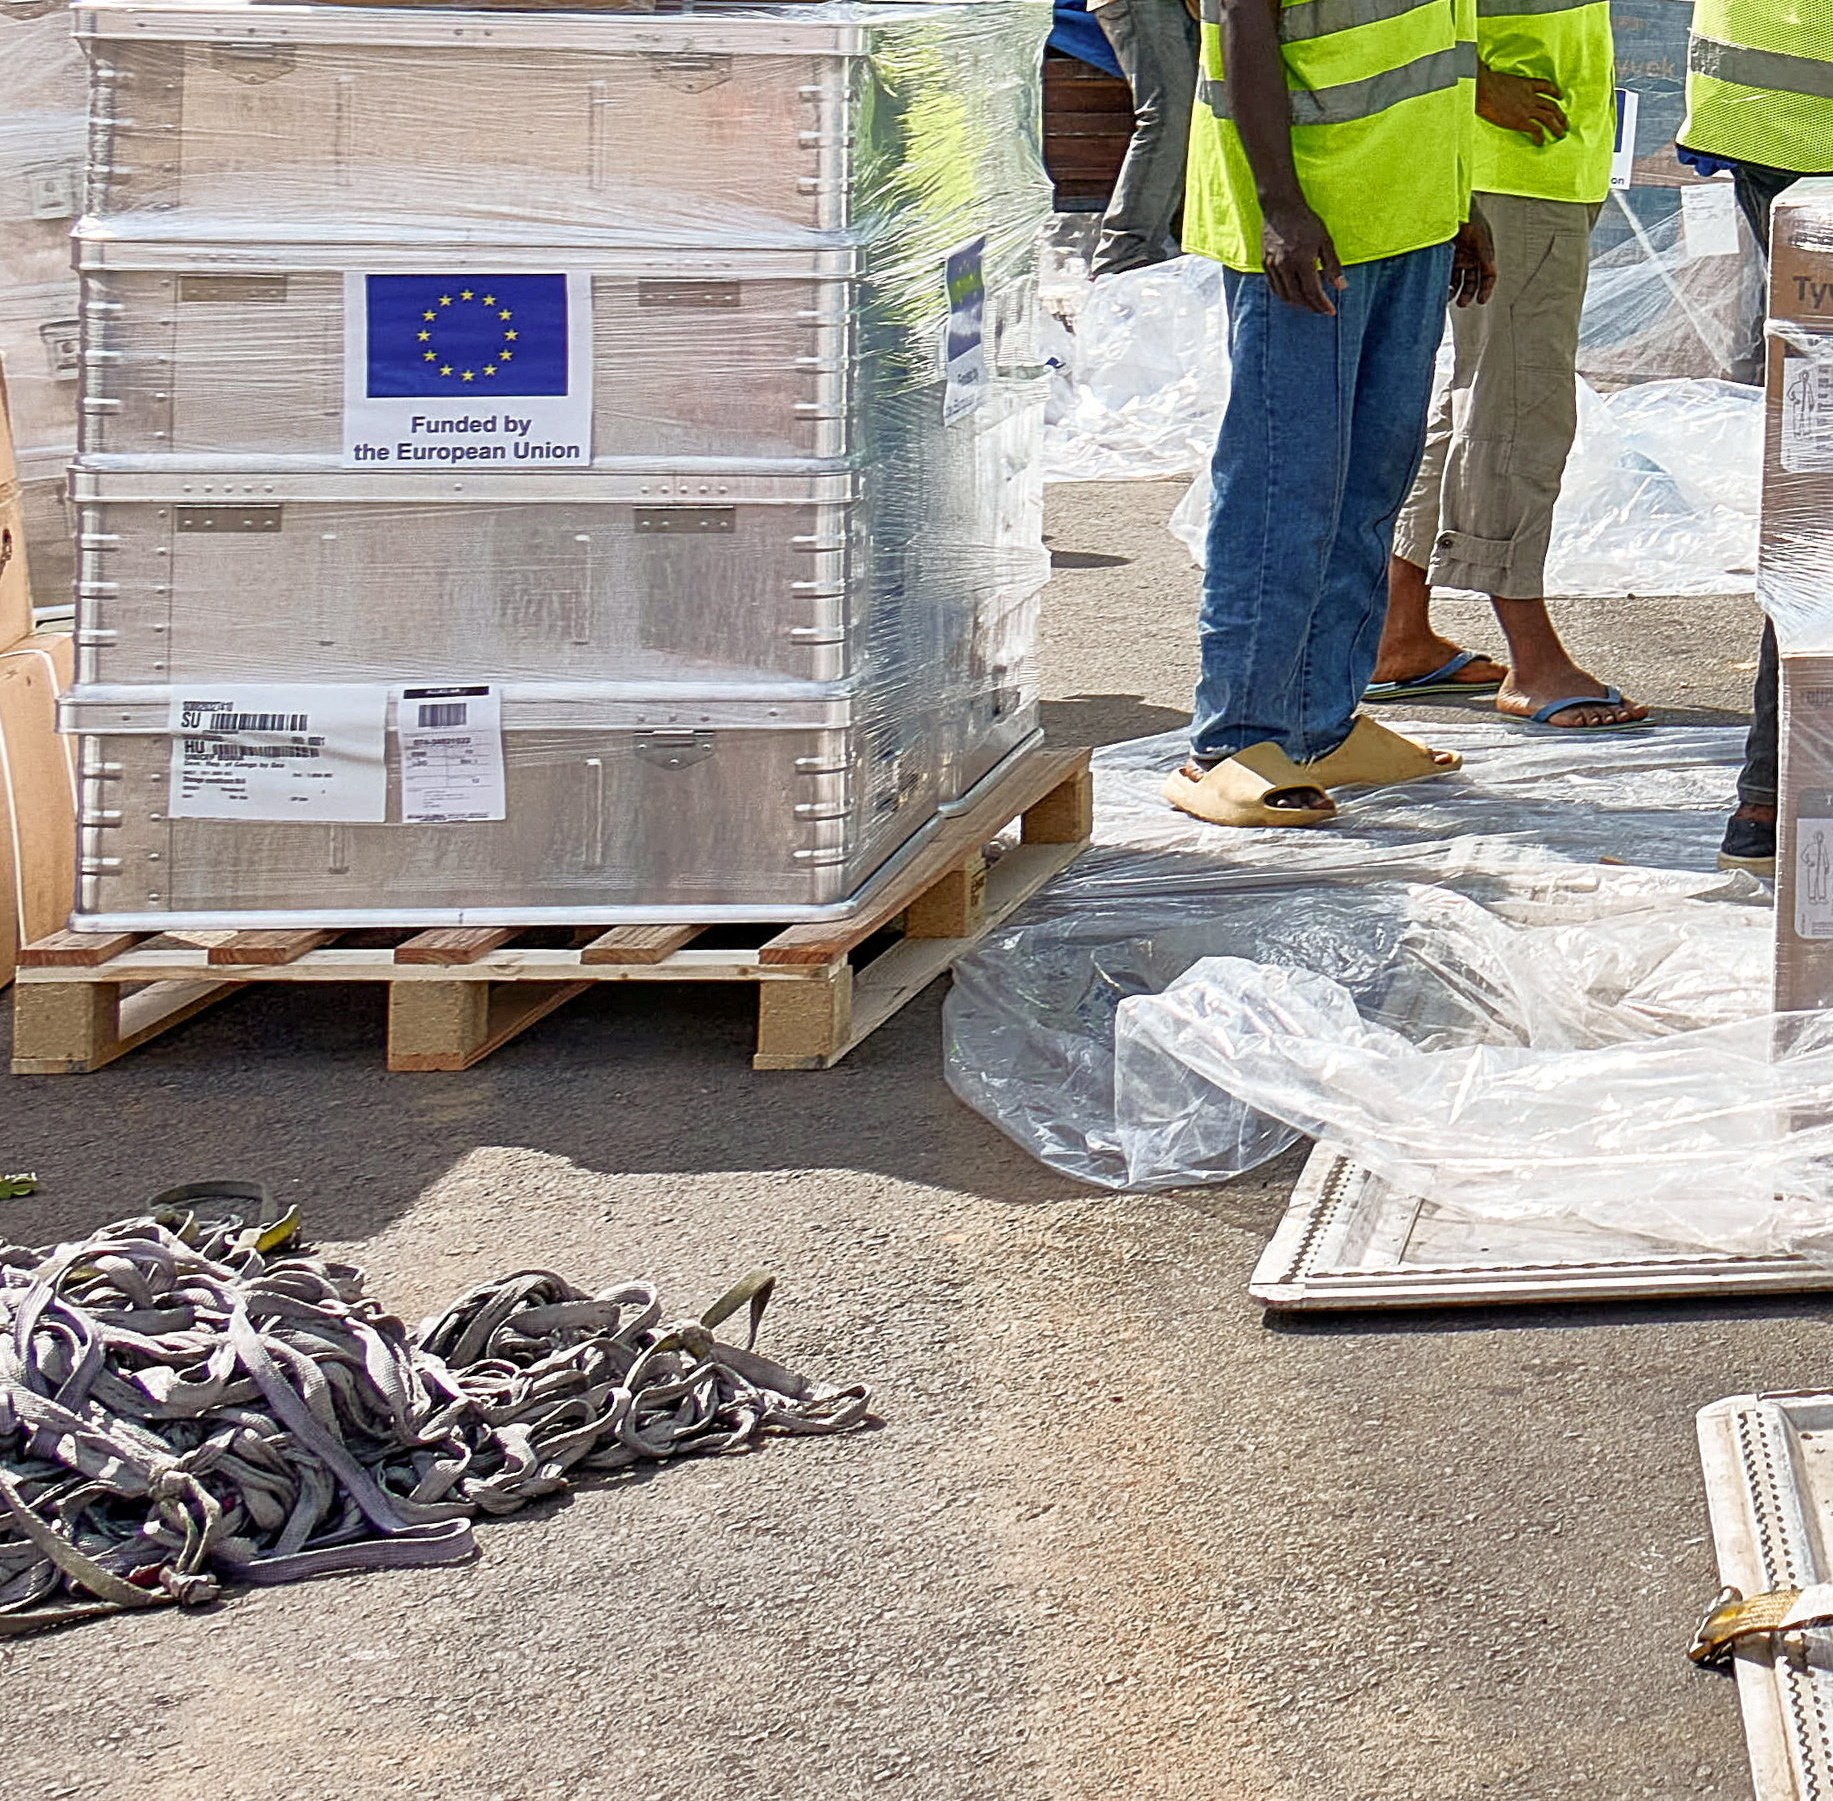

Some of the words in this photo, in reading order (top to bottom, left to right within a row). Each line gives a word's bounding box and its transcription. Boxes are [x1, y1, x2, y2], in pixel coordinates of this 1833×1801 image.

[411, 416, 496, 433] Funded
[504, 416, 532, 436] by
[354, 443, 390, 461] the
[397, 442, 505, 464] European
[513, 442, 580, 460] Union
[181, 712, 201, 728] SU
[185, 740, 205, 754] HU
